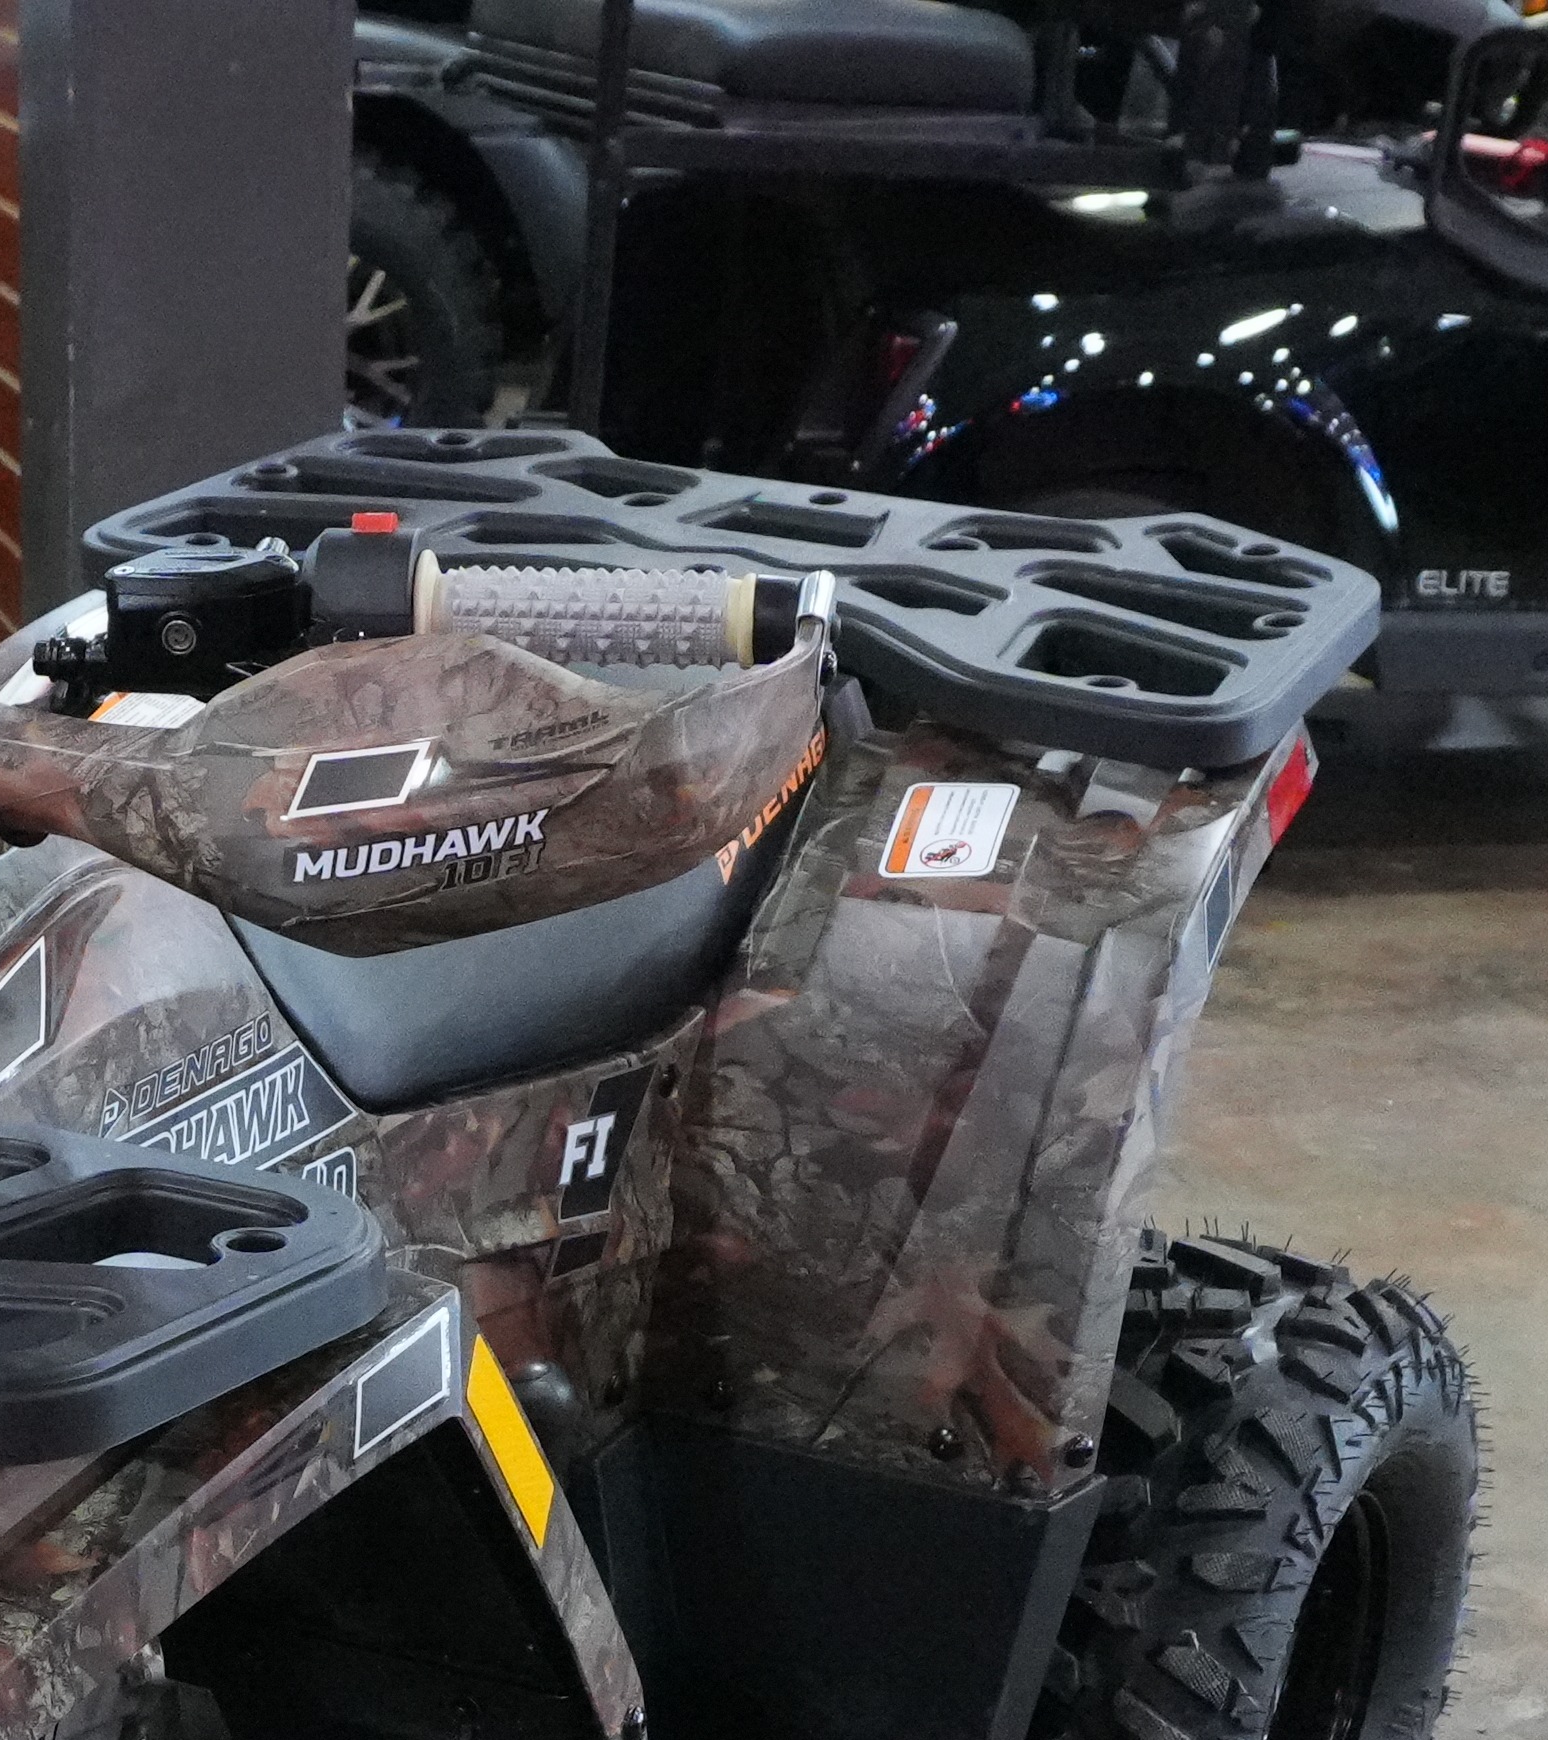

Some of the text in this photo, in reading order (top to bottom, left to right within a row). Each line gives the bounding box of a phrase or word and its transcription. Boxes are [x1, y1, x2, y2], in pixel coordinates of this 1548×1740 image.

[1417, 570, 1511, 598] ELITE
[292, 807, 550, 883] MUDHAWK
[130, 1010, 273, 1122] DENAGO
[558, 1113, 615, 1186] FI
